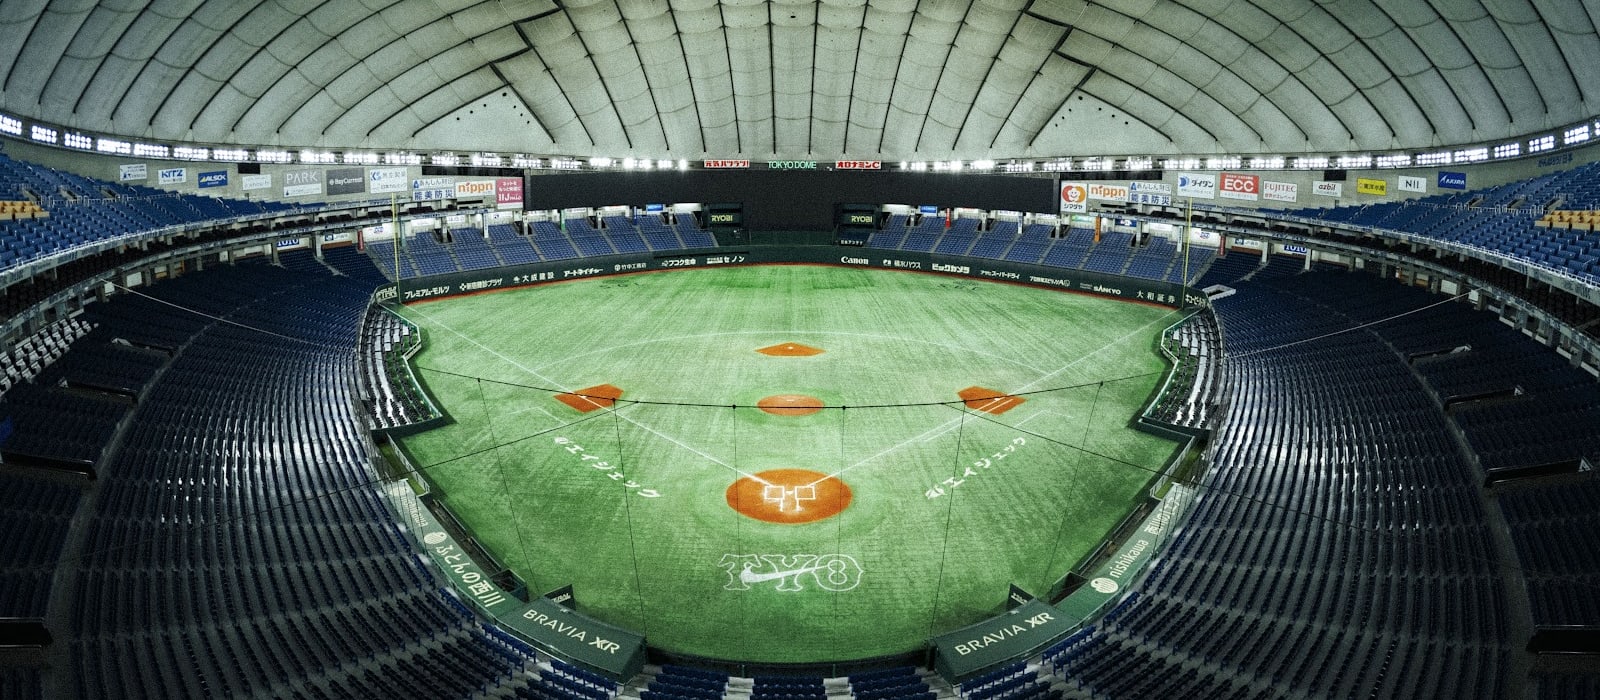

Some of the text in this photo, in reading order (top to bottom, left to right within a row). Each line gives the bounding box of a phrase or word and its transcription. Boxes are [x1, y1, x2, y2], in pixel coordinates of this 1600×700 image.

[161, 169, 183, 179] KITZ
[200, 174, 226, 183] ALSOK
[287, 171, 318, 184] PARK
[458, 182, 493, 193] nippn
[1224, 178, 1254, 192] ECC
[1265, 182, 1296, 193] FUJITEC
[1318, 183, 1336, 191] azbil
[414, 190, 453, 201] 能美防災
[1090, 186, 1126, 197] nippn
[1131, 193, 1170, 205] 能美防災
[851, 215, 873, 223] RYOBI
[841, 256, 869, 265] Canon
[932, 263, 970, 274] ビックカメラ
[1093, 284, 1121, 295] SANKYO
[565, 444, 661, 498] エイジェック
[1109, 539, 1149, 578] nishikawa
[435, 544, 506, 608] ふとんの西川
[523, 609, 620, 654] BRAVIA XR
[954, 612, 1055, 656] BRAVIA XR
